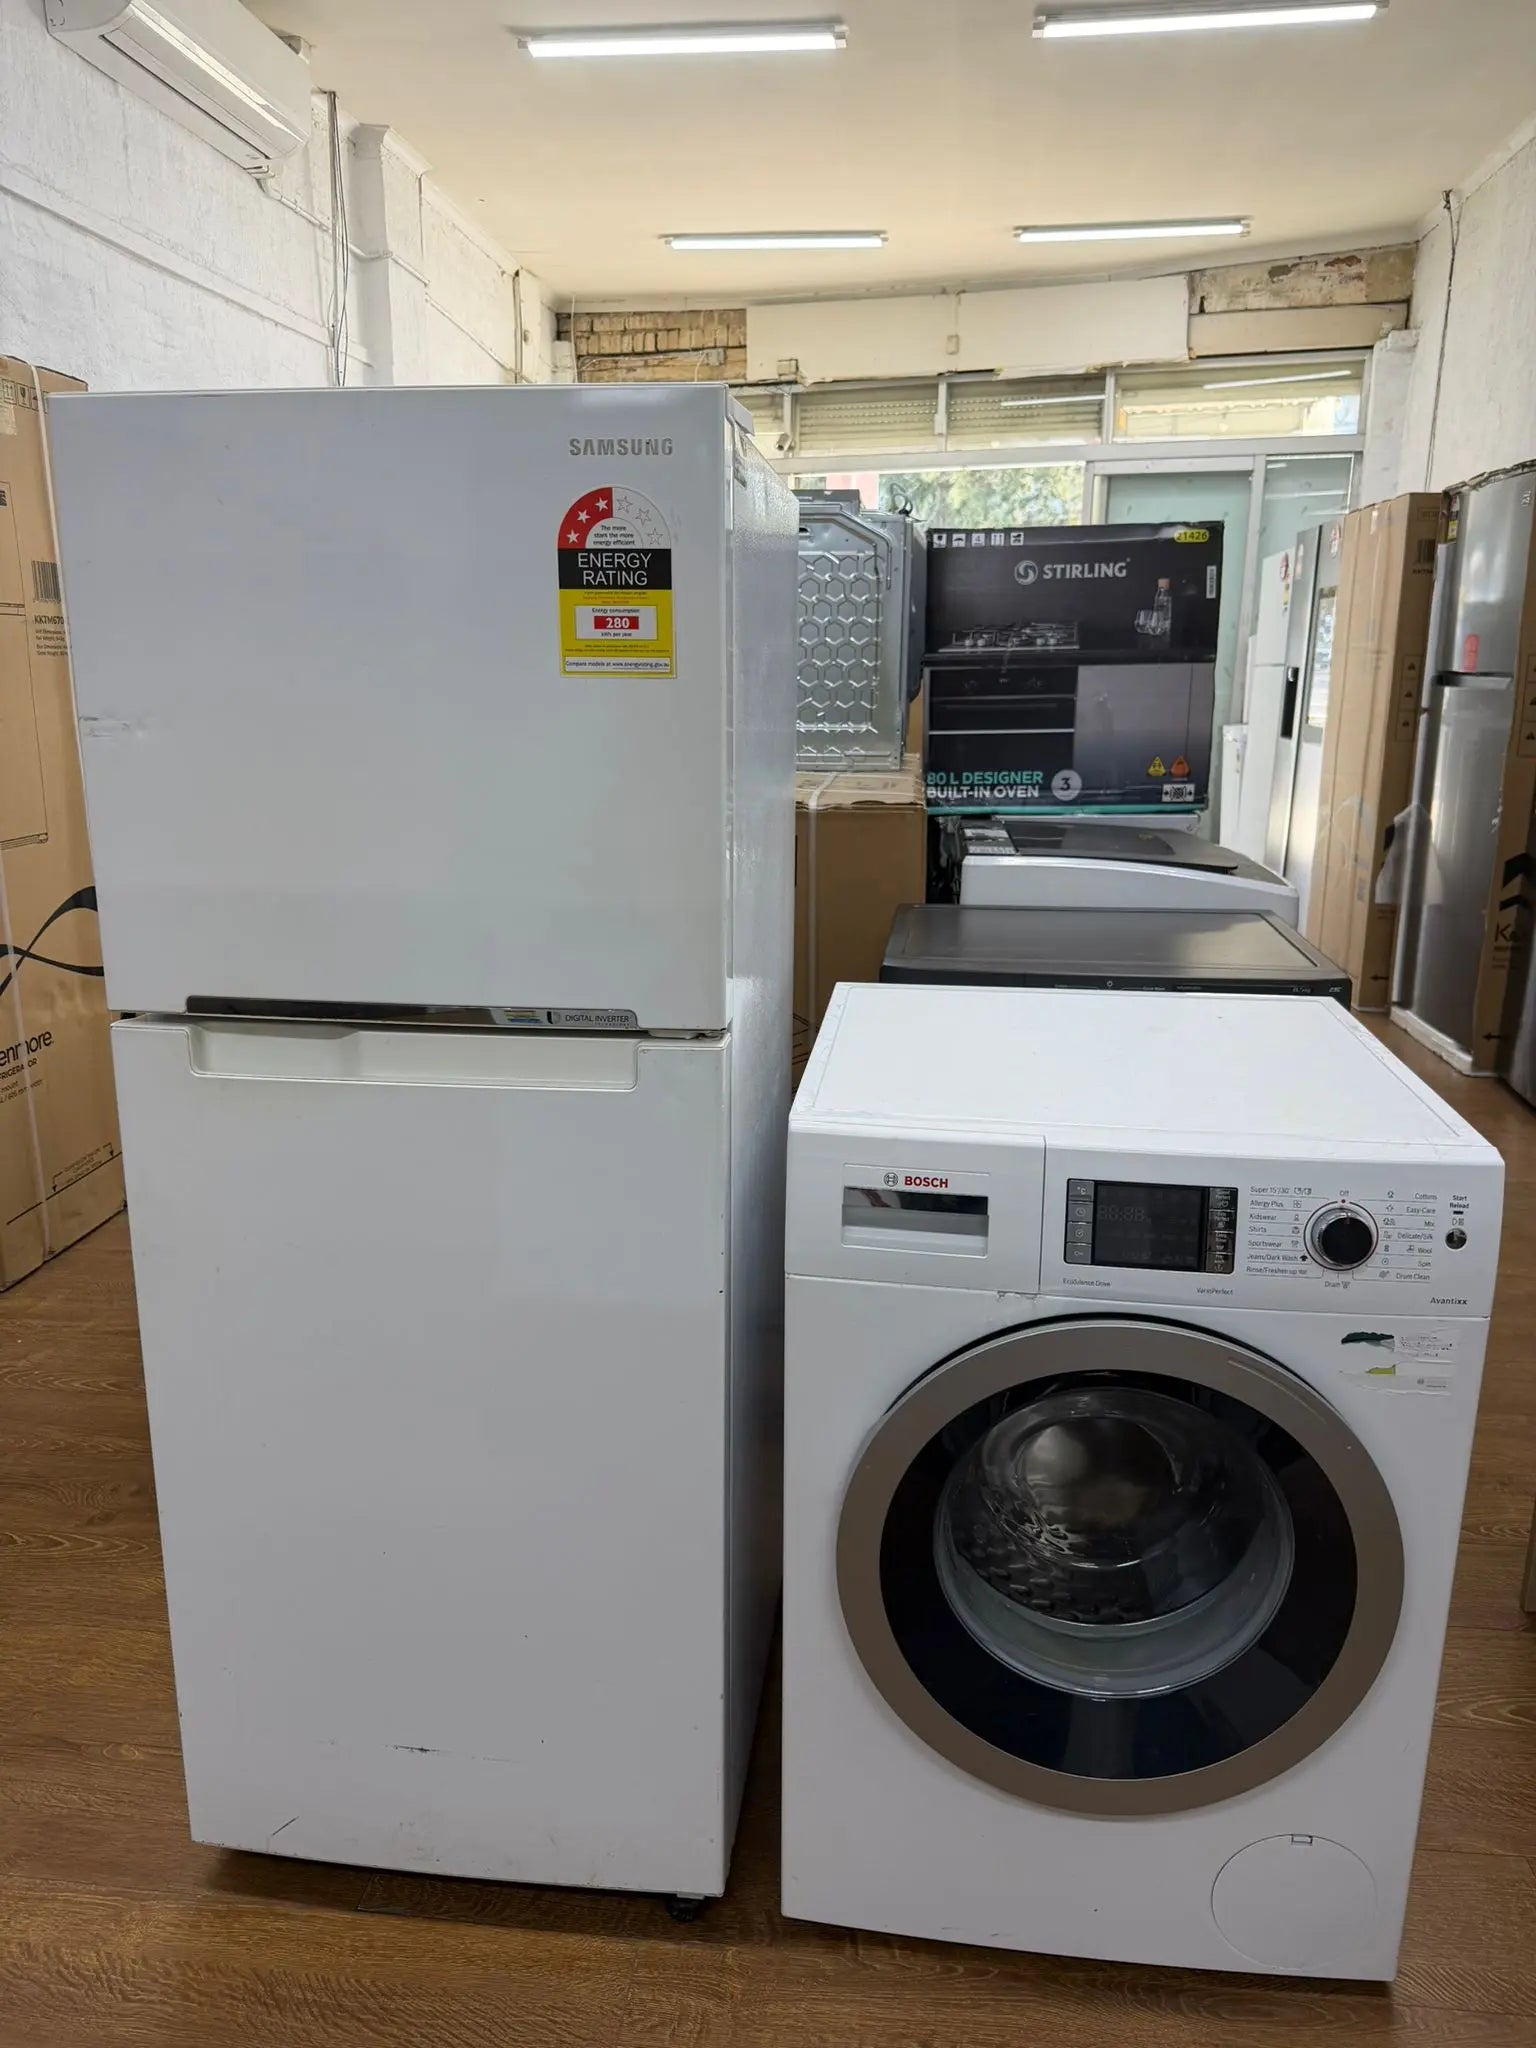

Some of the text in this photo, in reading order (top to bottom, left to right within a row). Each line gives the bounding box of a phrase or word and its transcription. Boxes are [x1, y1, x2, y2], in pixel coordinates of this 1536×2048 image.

[568, 437, 674, 456] SAMSUNG
[577, 552, 652, 569] ENERGY
[1042, 561, 1127, 580] STIRLING
[582, 570, 648, 586] RATING
[606, 617, 630, 629] 280
[926, 771, 1044, 785] 80 L DESIGNER
[1060, 777, 1072, 791] 3
[926, 785, 1039, 799] BUILT-IN OVEN
[565, 1014, 630, 1023] DIGITAL INVERTER
[903, 1175, 949, 1189] BOSCH
[1250, 1200, 1270, 1208] Allergy
[1449, 1202, 1470, 1210] Reload
[1248, 1240, 1282, 1248] Sportswear
[1430, 1297, 1468, 1305] Avantixx
